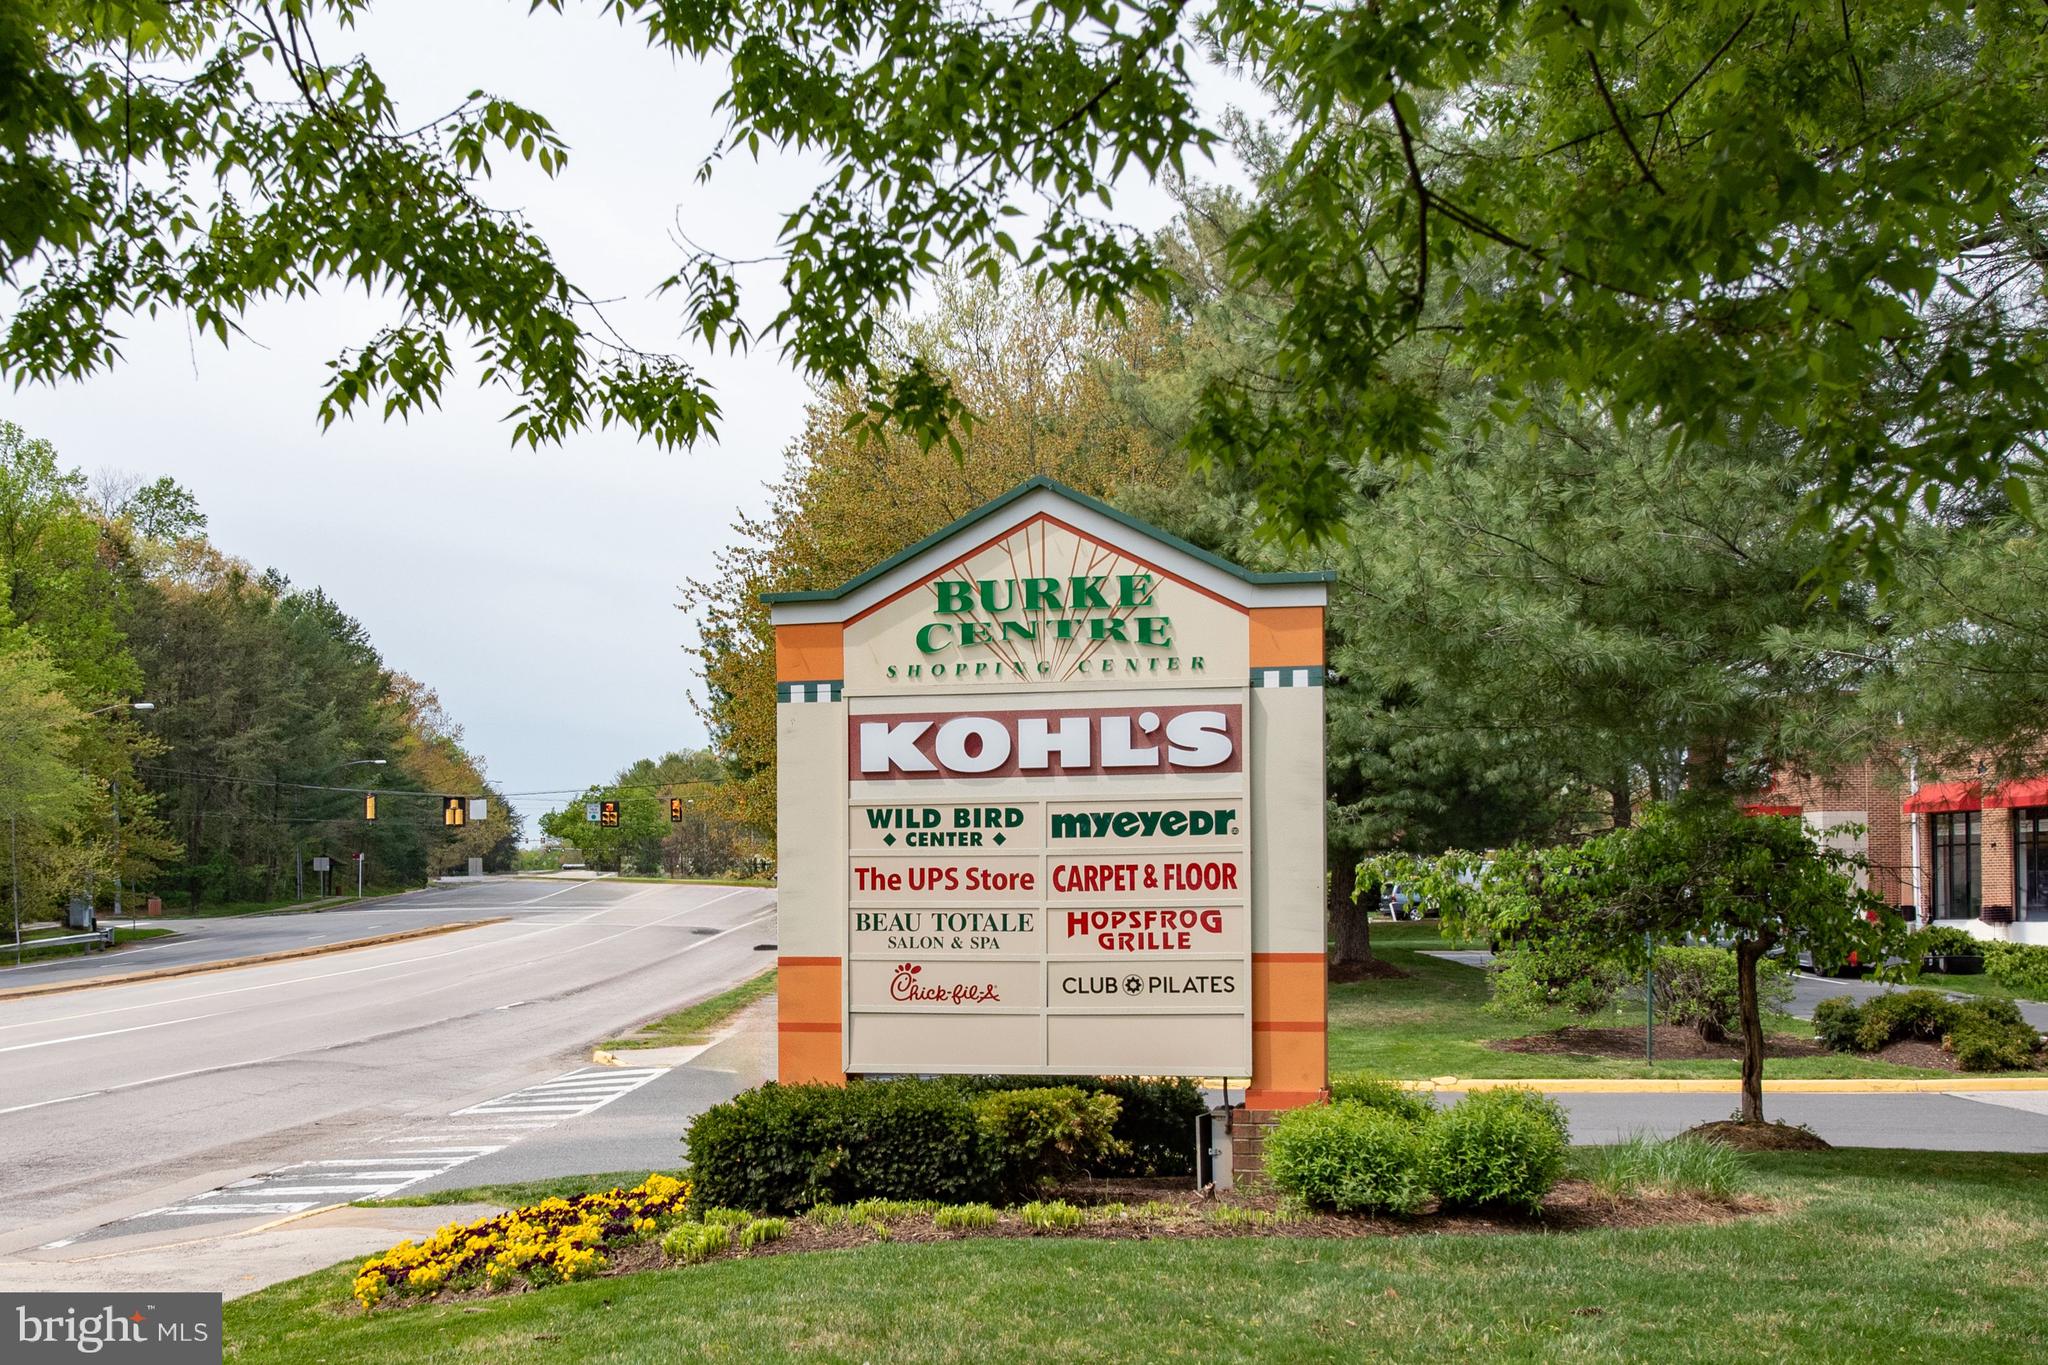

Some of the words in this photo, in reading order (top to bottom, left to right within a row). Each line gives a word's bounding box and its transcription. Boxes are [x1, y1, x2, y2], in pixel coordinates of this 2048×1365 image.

[934, 574, 1153, 614] BURKE
[915, 617, 1173, 654] CENTRE
[886, 660, 1051, 679] SHOPPING
[1078, 656, 1206, 673] CENTER
[860, 711, 1233, 772] KOHL'S
[866, 808, 941, 830] WILD
[953, 807, 1024, 829] BIRD
[905, 829, 983, 847] CENTER
[855, 867, 902, 891] The
[908, 867, 959, 891] UPS
[965, 867, 1035, 891] Store
[1053, 864, 1138, 892] CARPET
[1143, 864, 1158, 889] &
[1164, 862, 1238, 891] FLOOR
[856, 913, 922, 932] BEAU
[931, 913, 1034, 932] TOTALE
[1067, 909, 1222, 938] HOPSFROG
[887, 935, 944, 949] SALON
[951, 936, 963, 949] &
[970, 936, 1000, 949] SPA
[1098, 931, 1192, 952] GRILLE
[890, 964, 1001, 1004] Chick-fil-A
[1063, 976, 1118, 994] CLUB
[1148, 975, 1235, 994] PILATES
